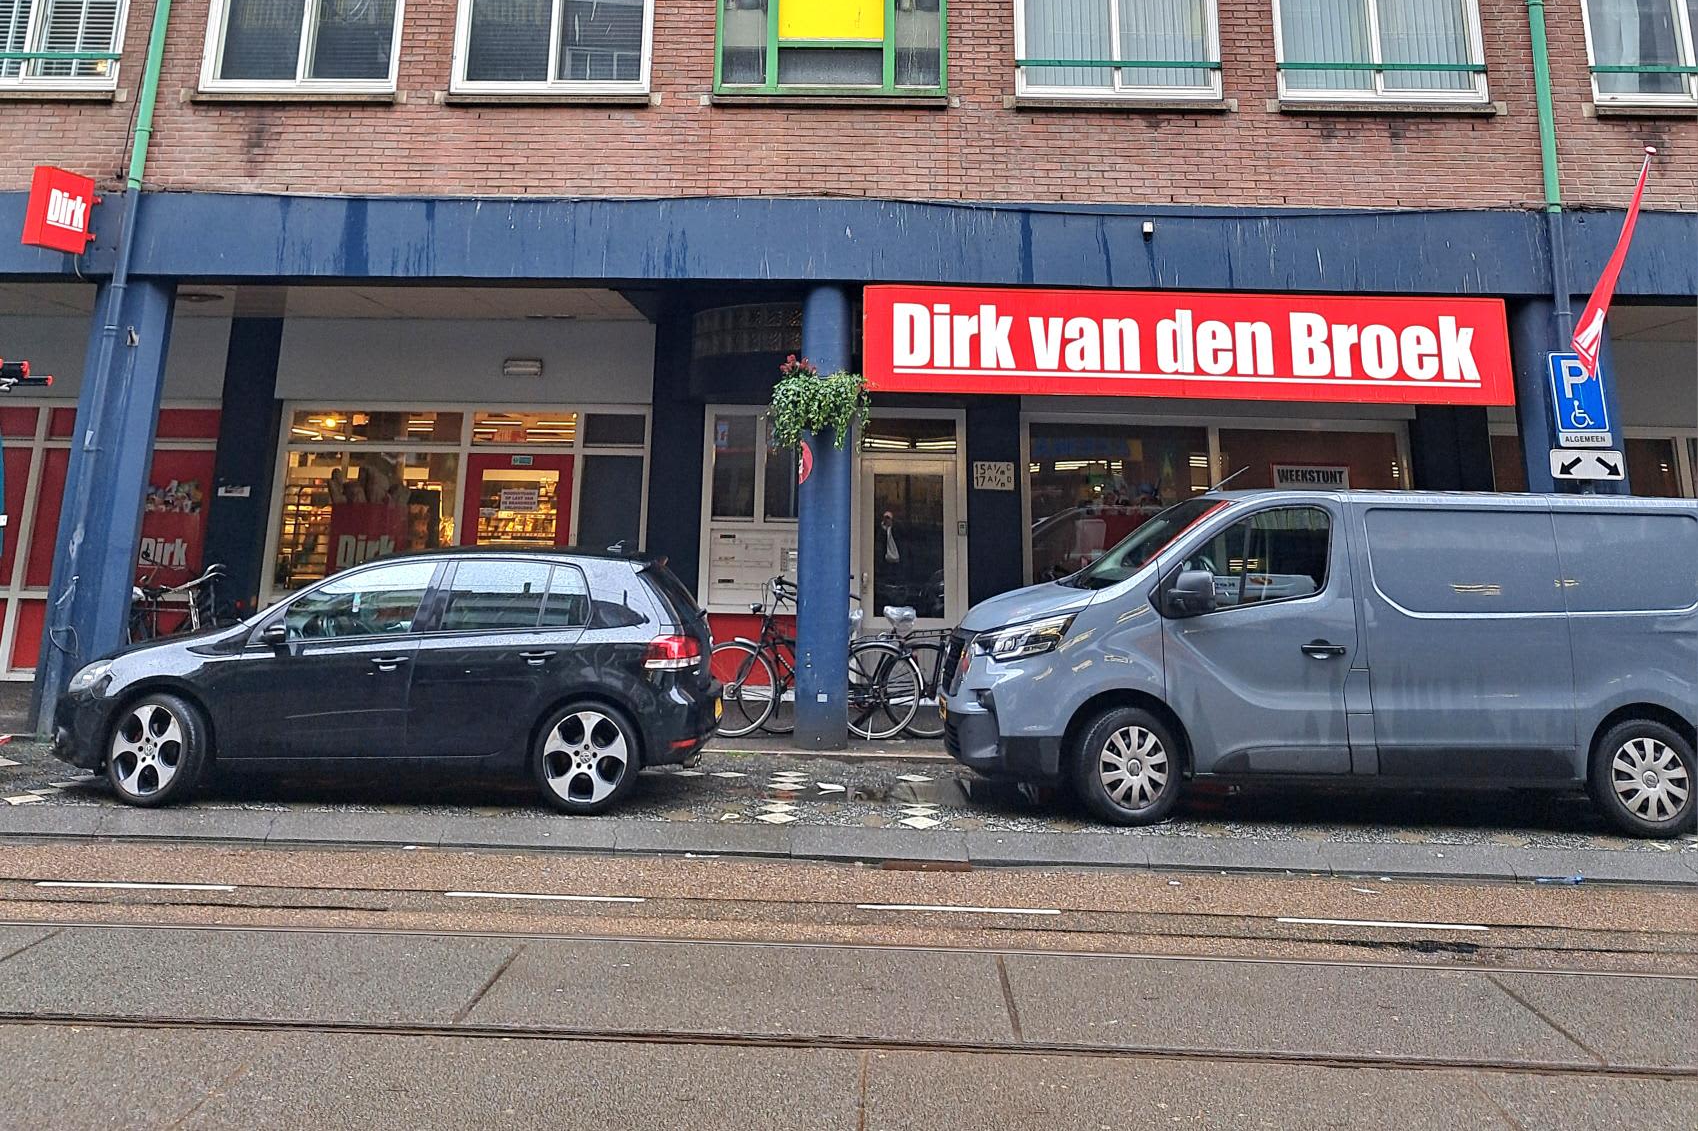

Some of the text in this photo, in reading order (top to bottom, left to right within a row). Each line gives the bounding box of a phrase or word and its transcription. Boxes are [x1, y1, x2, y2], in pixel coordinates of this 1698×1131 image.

[46, 188, 87, 229] Dirk
[893, 302, 1482, 381] Dirk van den Broek
[1560, 359, 1590, 399] P
[1564, 435, 1607, 444] ALGEMEEN
[1277, 468, 1345, 484] WEEKSTUNT
[138, 537, 188, 566] Dirk
[336, 535, 395, 568] Dirk
